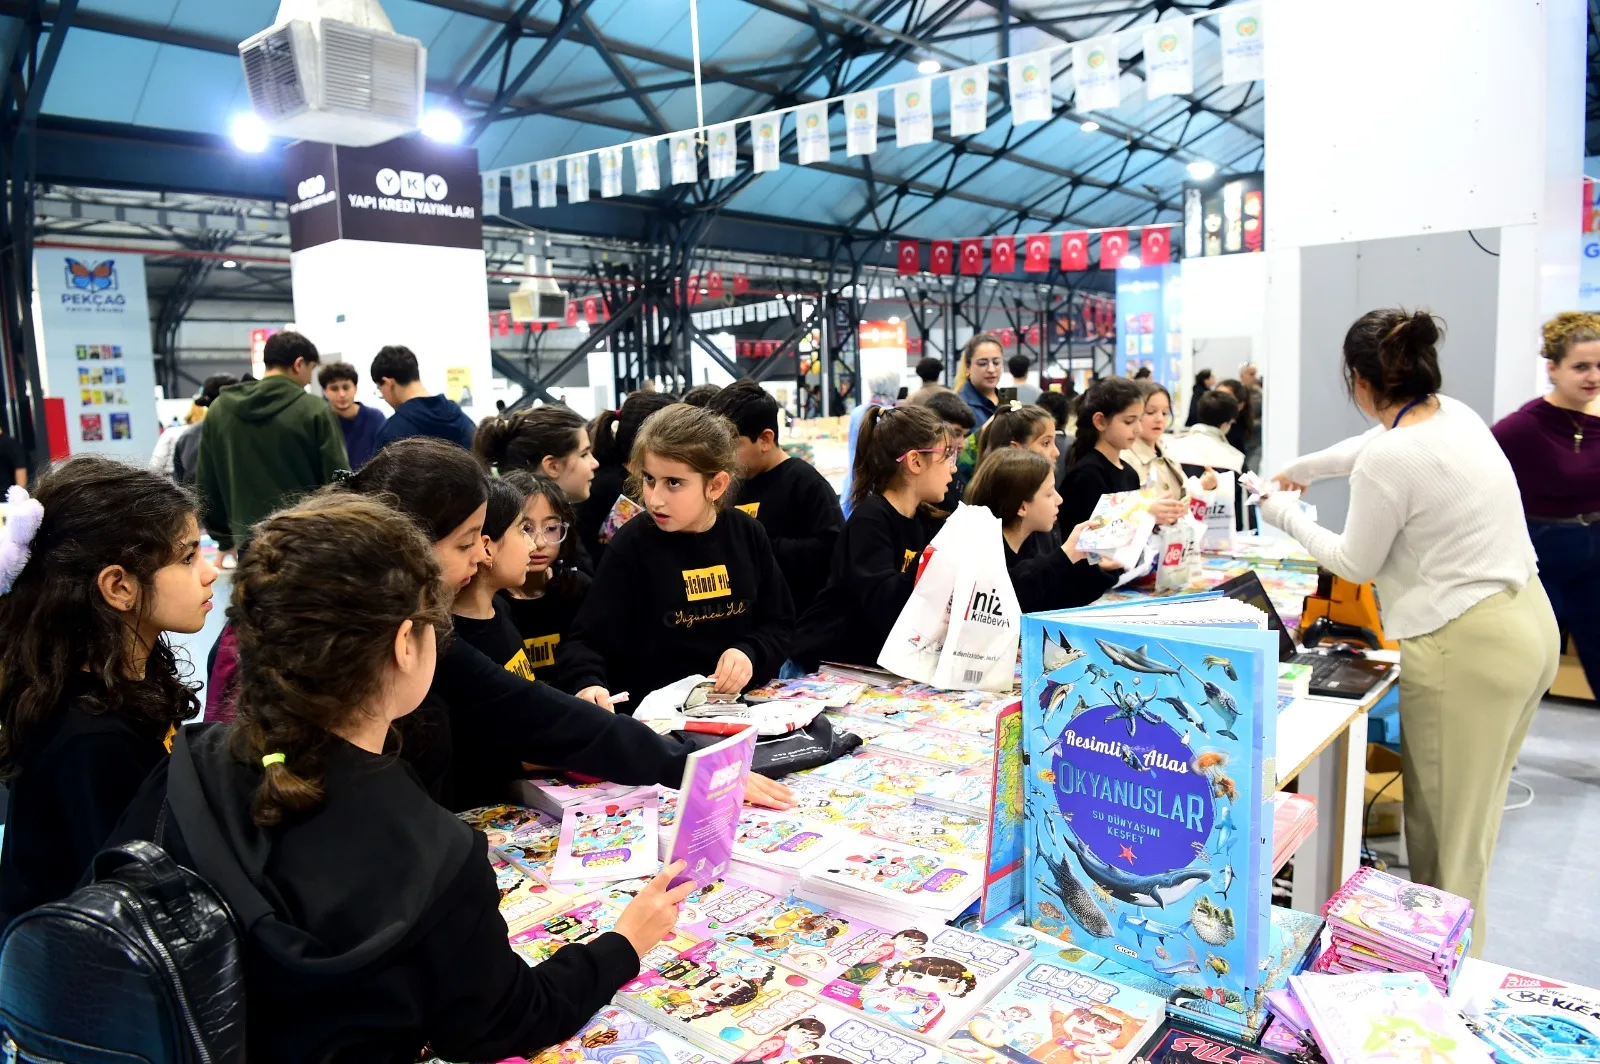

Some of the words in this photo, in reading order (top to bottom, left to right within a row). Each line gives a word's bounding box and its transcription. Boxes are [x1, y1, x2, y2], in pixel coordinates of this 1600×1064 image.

[348, 194, 377, 209] YAPI
[378, 197, 416, 213] KREDİ
[416, 201, 475, 219] YAYINLARI
[1065, 729, 1122, 758] Resimli
[1142, 749, 1189, 774] Atlas
[1058, 760, 1205, 833] OKYANUSLAR
[1092, 810, 1105, 821] SU
[1107, 812, 1161, 838] DÜNYASINI
[1107, 826, 1144, 845] KEŞFET
